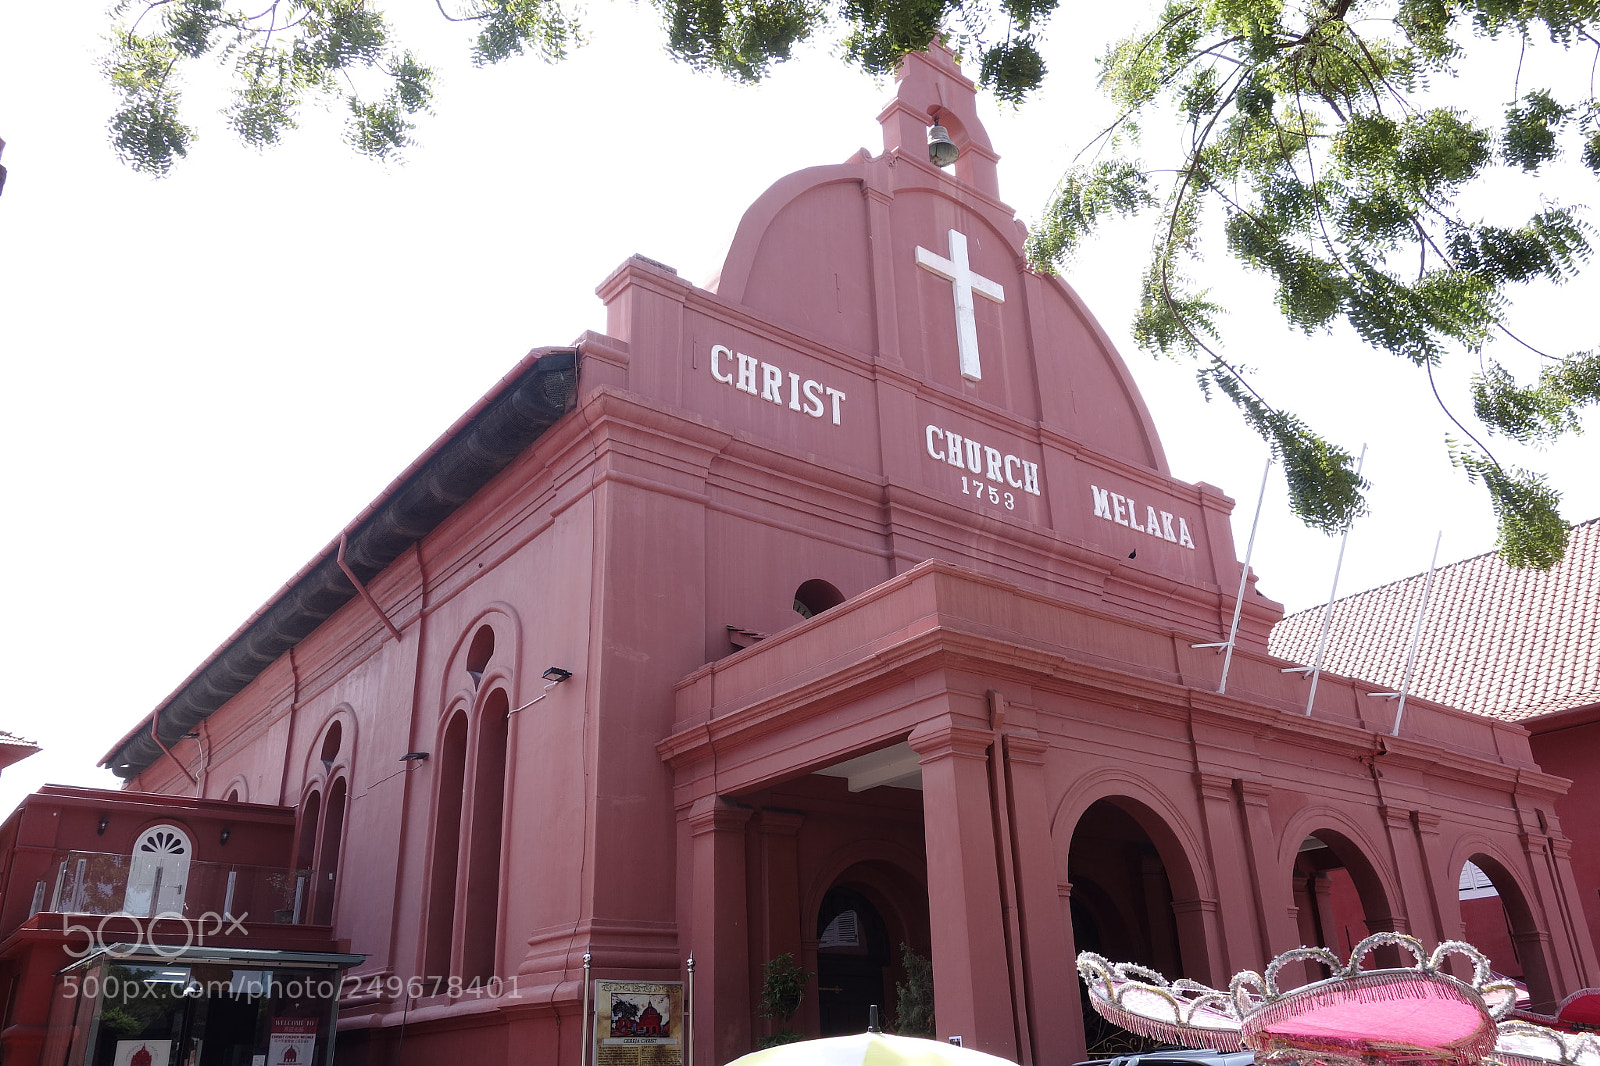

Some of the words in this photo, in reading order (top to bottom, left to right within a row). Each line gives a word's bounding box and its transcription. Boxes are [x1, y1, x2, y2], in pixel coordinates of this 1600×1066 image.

[709, 344, 846, 426] CHRIST
[925, 424, 1041, 497] CHURCH
[1091, 484, 1196, 550] MELAKA
[960, 475, 1016, 512] 1753
